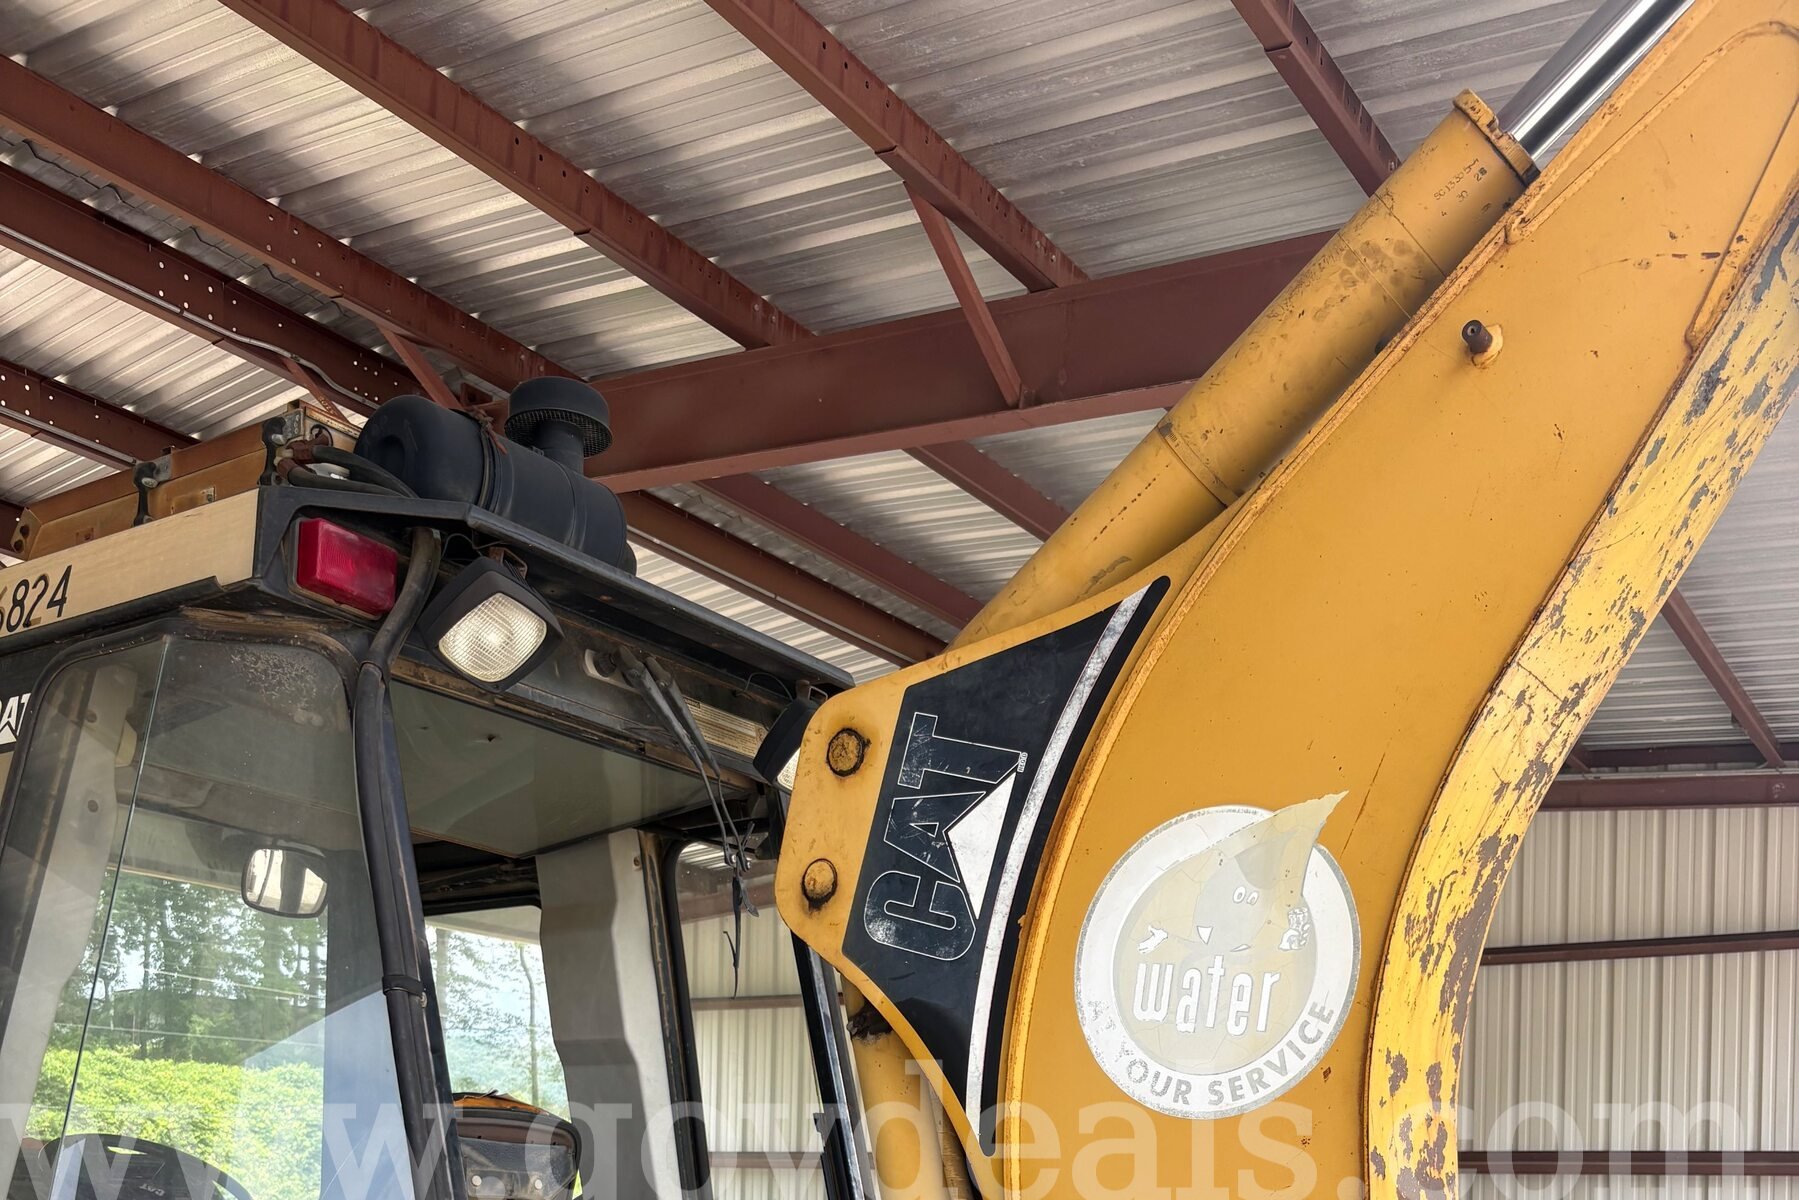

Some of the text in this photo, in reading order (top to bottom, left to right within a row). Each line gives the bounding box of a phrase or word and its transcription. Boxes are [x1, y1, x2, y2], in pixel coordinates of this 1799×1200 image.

[864, 711, 1022, 962] CAT
[1133, 955, 1281, 1037] water
[1208, 1000, 1334, 1106] SERVICE
